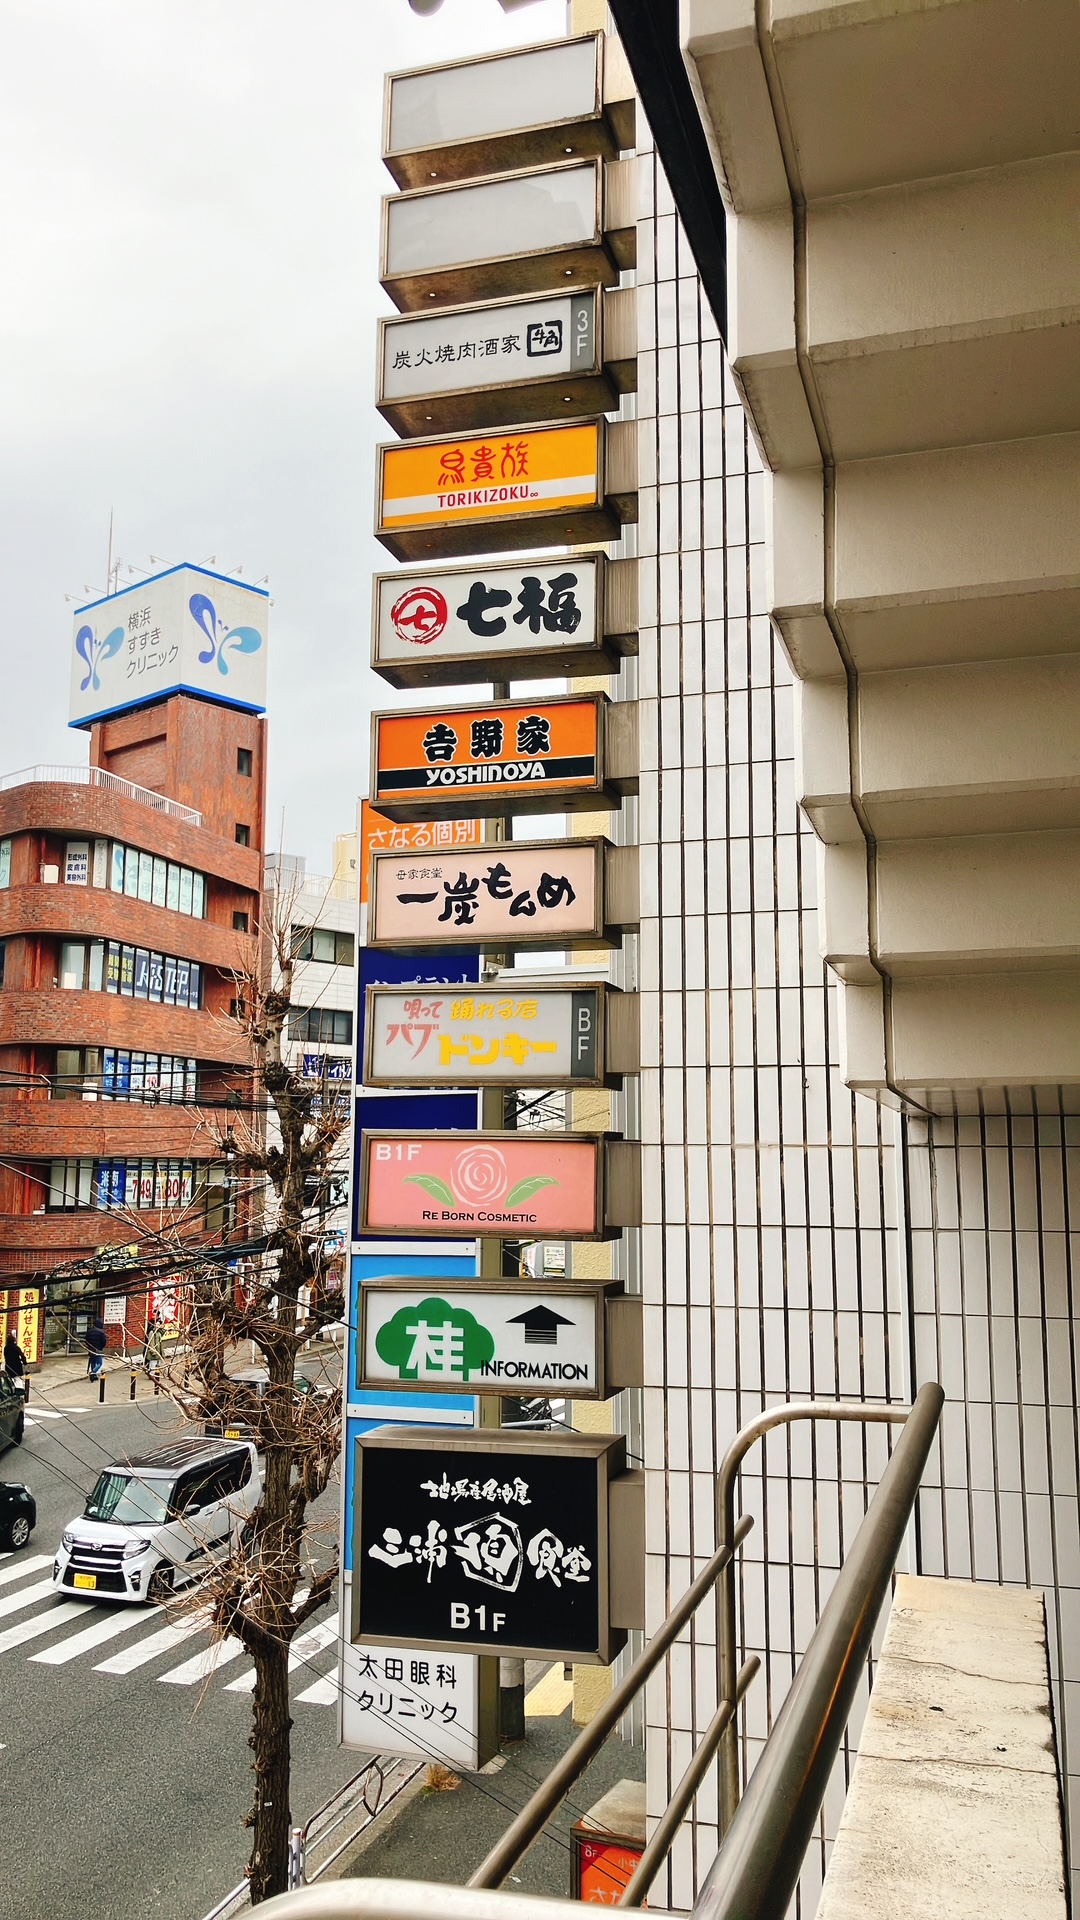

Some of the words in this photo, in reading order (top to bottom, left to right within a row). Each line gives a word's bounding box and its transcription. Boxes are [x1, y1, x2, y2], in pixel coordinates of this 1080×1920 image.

[392, 335, 521, 369] 炭火焼肉酒家
[438, 441, 529, 485] 鳥貴族
[128, 606, 151, 632] 横浜
[455, 571, 583, 637] 七福
[127, 627, 161, 655] すすき
[127, 645, 179, 679] クリニック
[426, 761, 546, 786] YOSHINOYA
[368, 818, 476, 849] さなる個別
[396, 862, 577, 926] 一炭もんめ
[403, 998, 444, 1020] 唄って
[449, 997, 539, 1021] 踊れる店
[386, 1023, 440, 1060] パブ
[438, 1033, 557, 1066] ドンキー
[376, 1144, 422, 1160] B1F
[405, 1319, 464, 1370] 桂
[480, 1359, 589, 1380] INFORMATION
[420, 1471, 532, 1506] 地場産居酒屋
[450, 1602, 506, 1633] B1F
[358, 1654, 458, 1690] 太田眼科
[358, 1690, 458, 1724] クリニック
